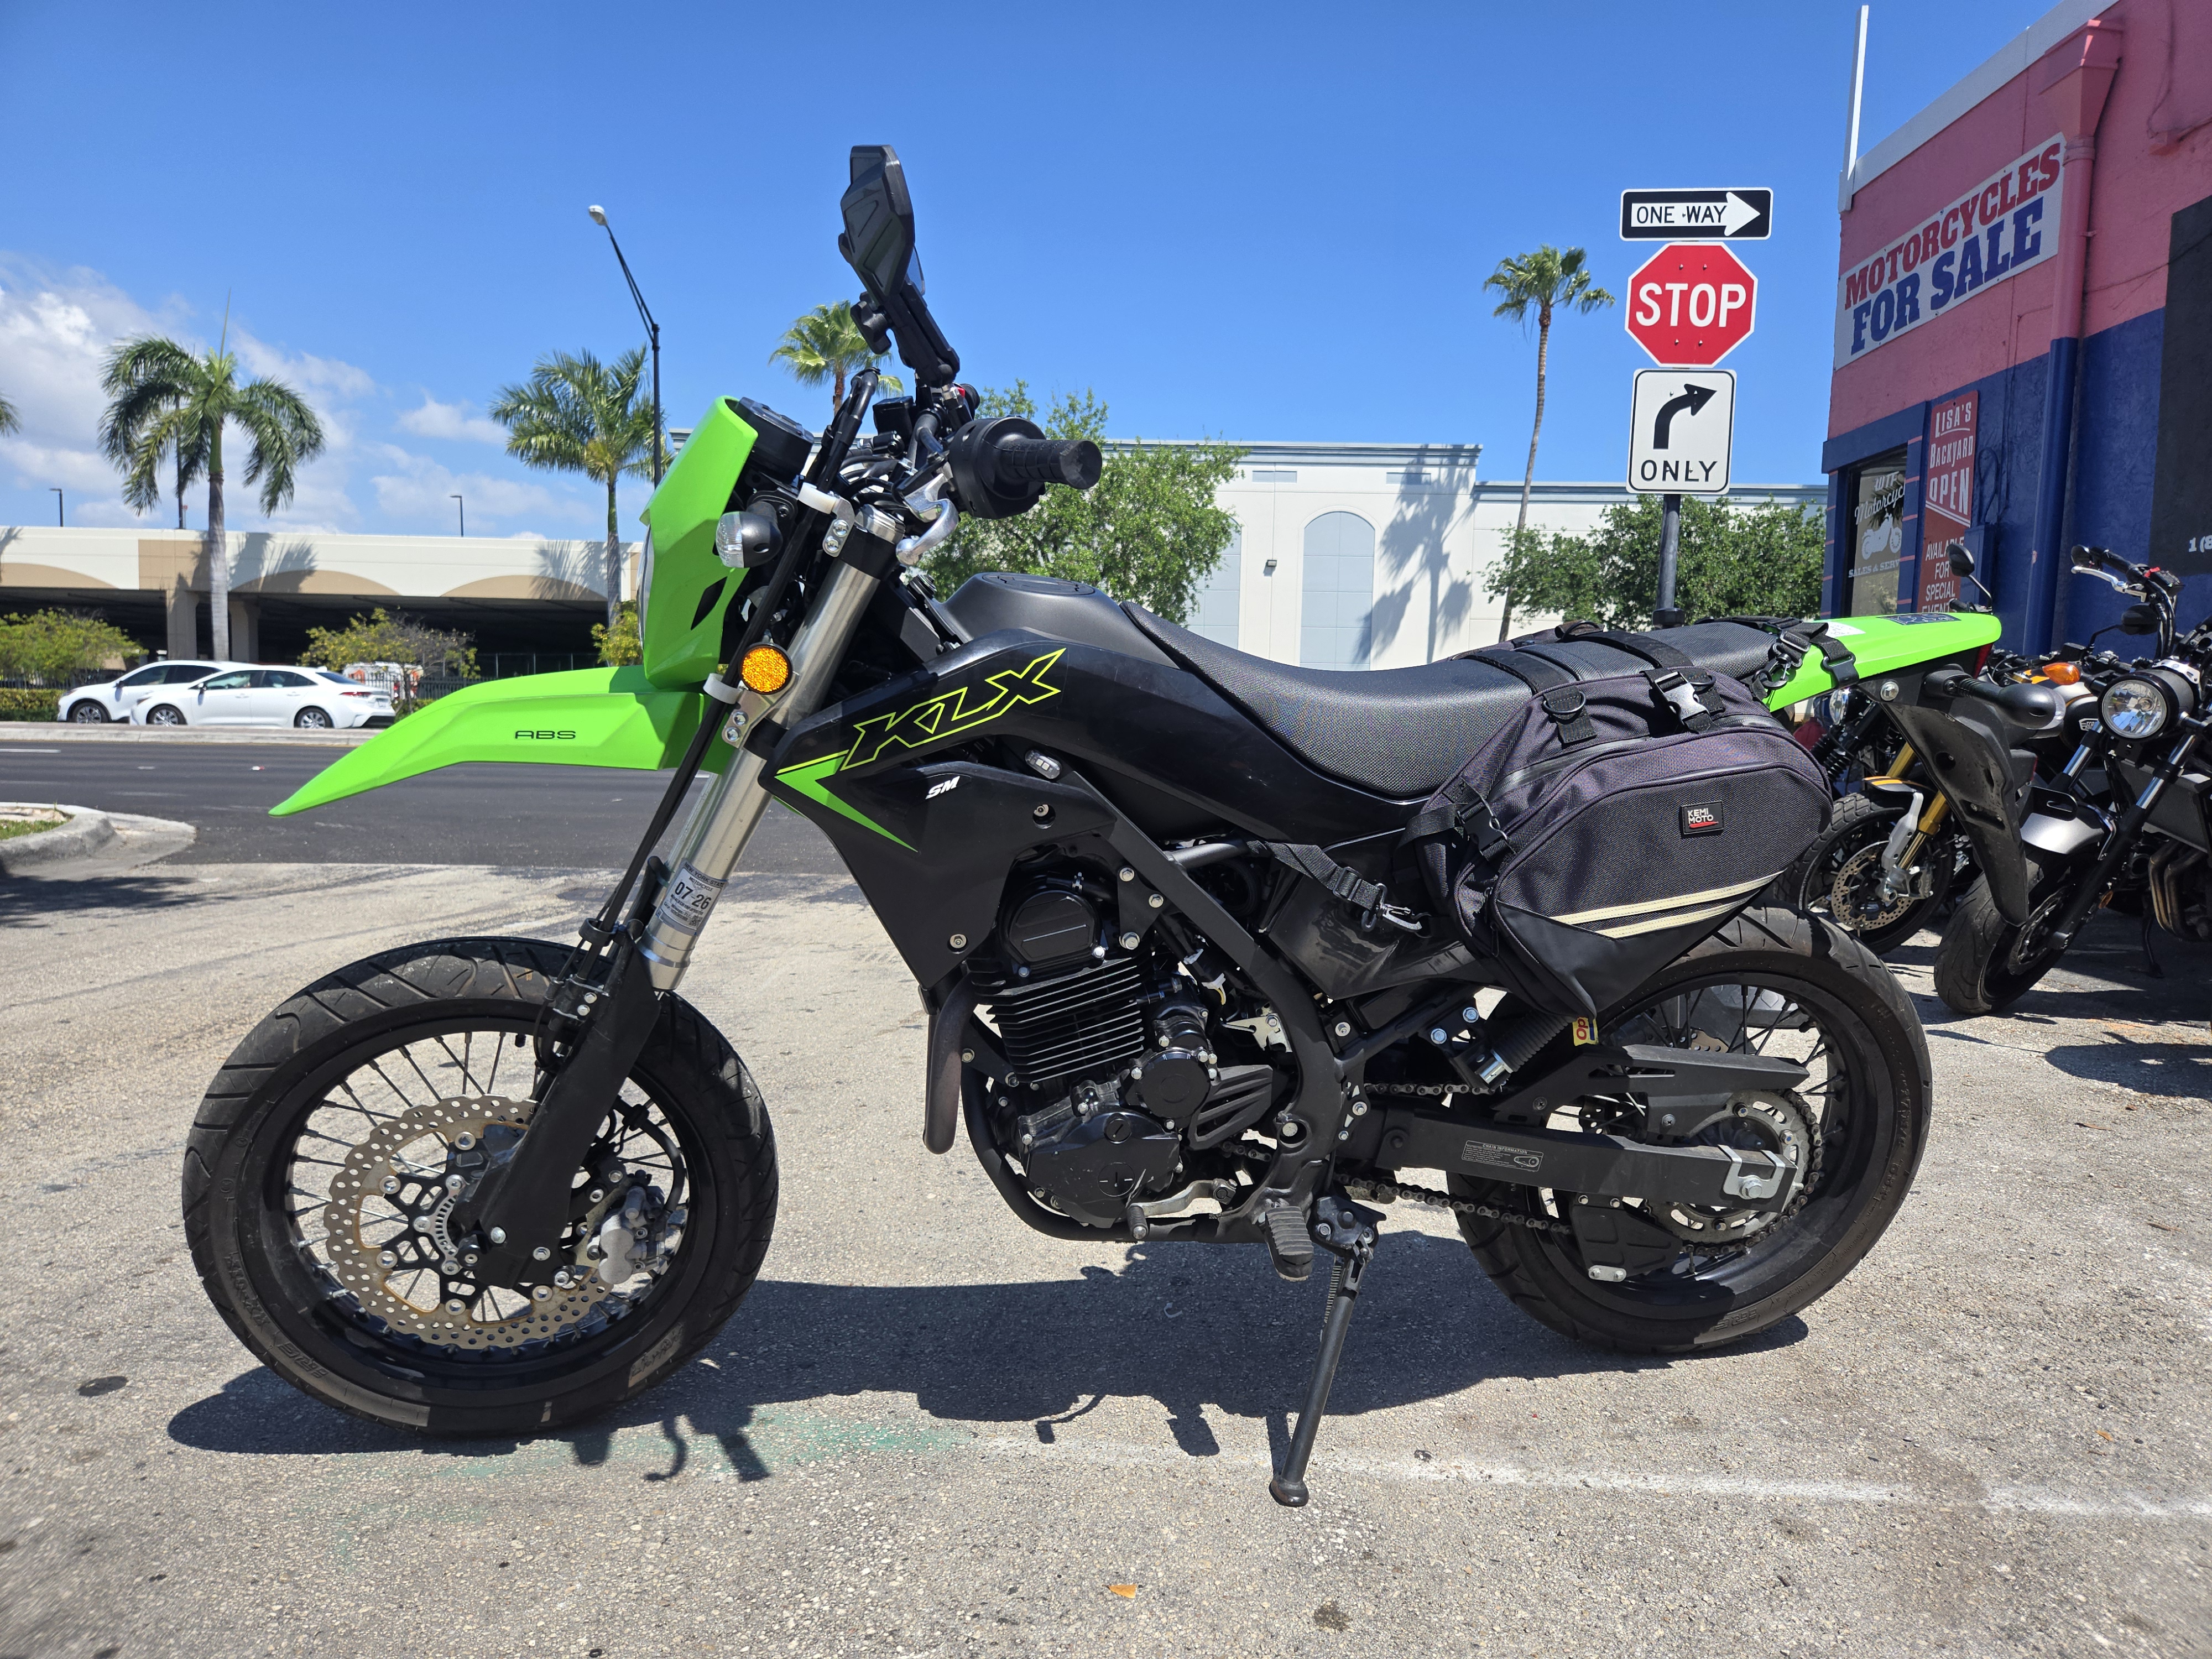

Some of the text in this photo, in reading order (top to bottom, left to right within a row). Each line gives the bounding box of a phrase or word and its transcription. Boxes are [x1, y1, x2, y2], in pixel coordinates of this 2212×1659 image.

[1637, 205, 1727, 223] ONE WAY
[1845, 143, 2060, 310] MOTORCYCLES
[1850, 196, 2044, 356] FOR SALE
[1636, 283, 1746, 327] STOP
[1935, 401, 1972, 438] LISA'S
[1641, 460, 1718, 482] ONLY
[1929, 467, 1970, 515] OPEN
[2188, 537, 2197, 552] 1
[1848, 564, 1872, 578] SALES
[1872, 564, 1879, 572] &
[1934, 561, 1950, 580] FOR
[1926, 580, 1955, 602] SPECIAL
[839, 648, 1067, 771] KLX
[515, 731, 576, 739] ABS
[925, 776, 960, 800] SM
[1687, 808, 1709, 817] KEMI
[1688, 815, 1714, 824] MOTO
[684, 862, 695, 873] NEW
[695, 873, 710, 883] YORK
[688, 876, 714, 892] MOTORCYCLE
